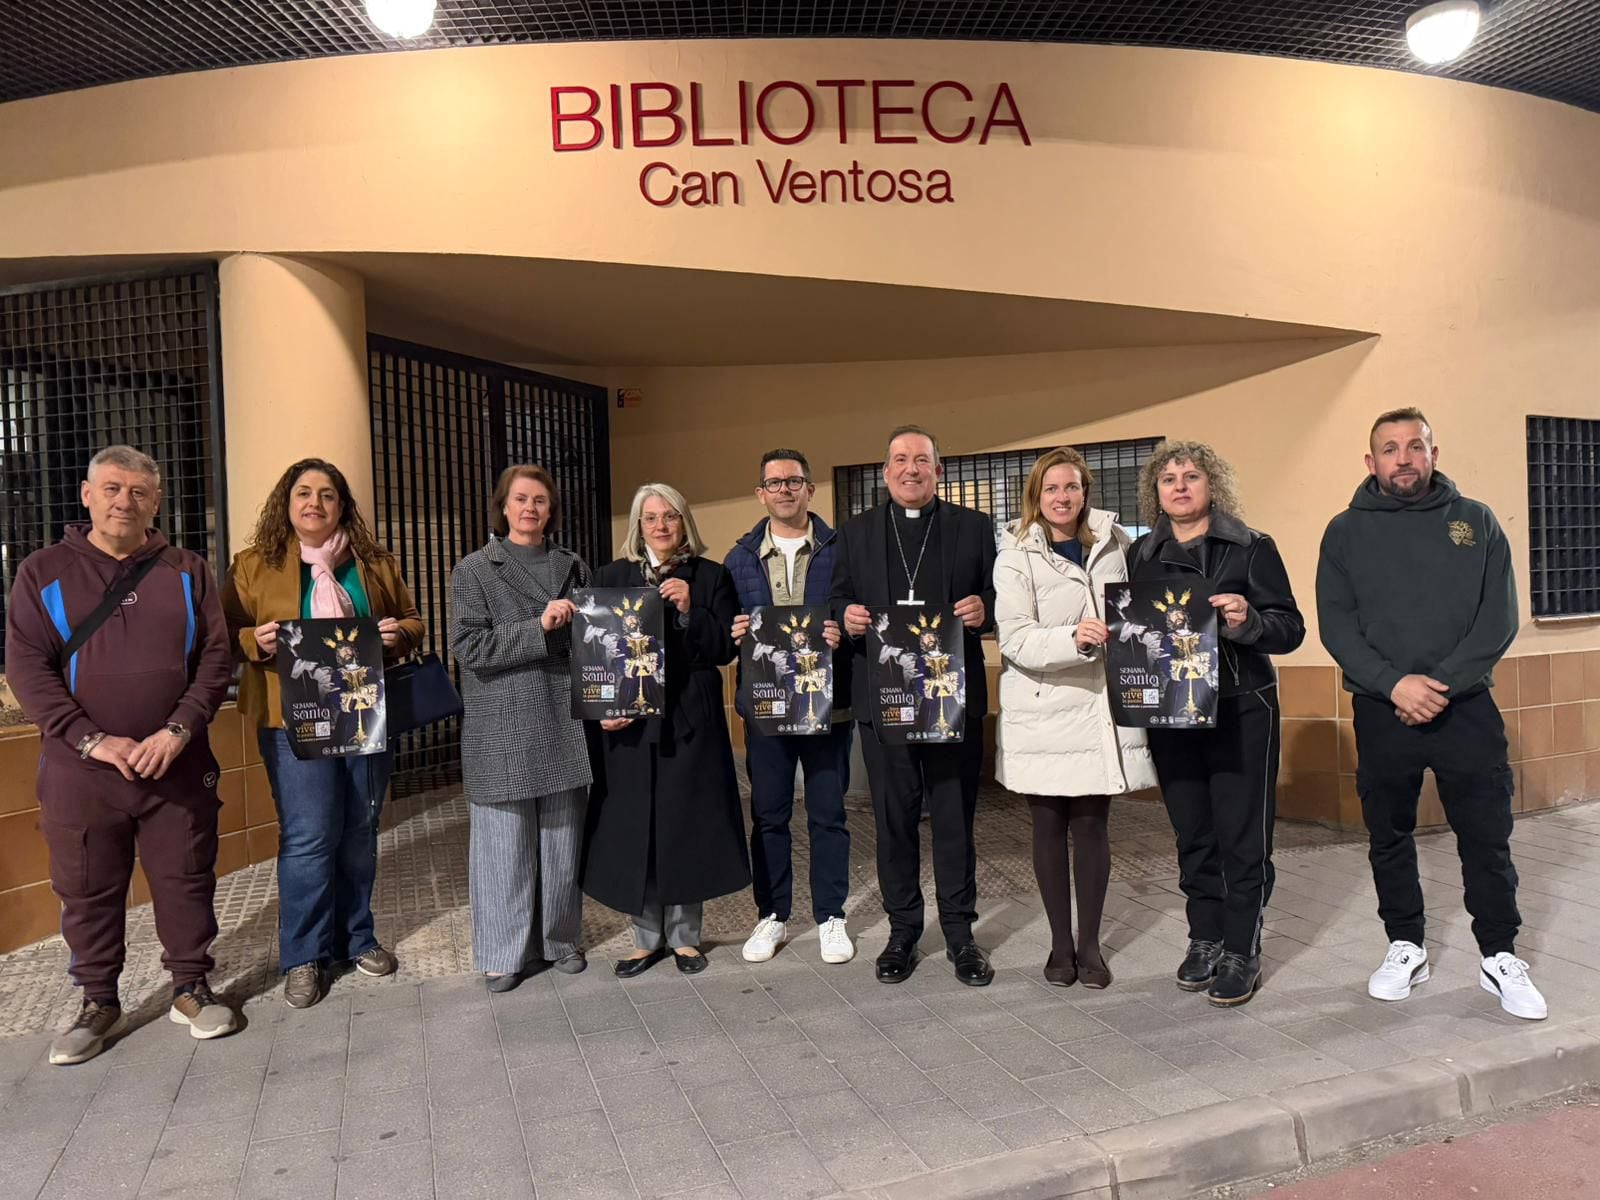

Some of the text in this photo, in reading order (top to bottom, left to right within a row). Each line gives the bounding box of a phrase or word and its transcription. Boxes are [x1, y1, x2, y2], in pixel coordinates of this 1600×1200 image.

[549, 79, 1031, 152] BIBLIOTECA
[638, 159, 954, 206] Can Ventosa
